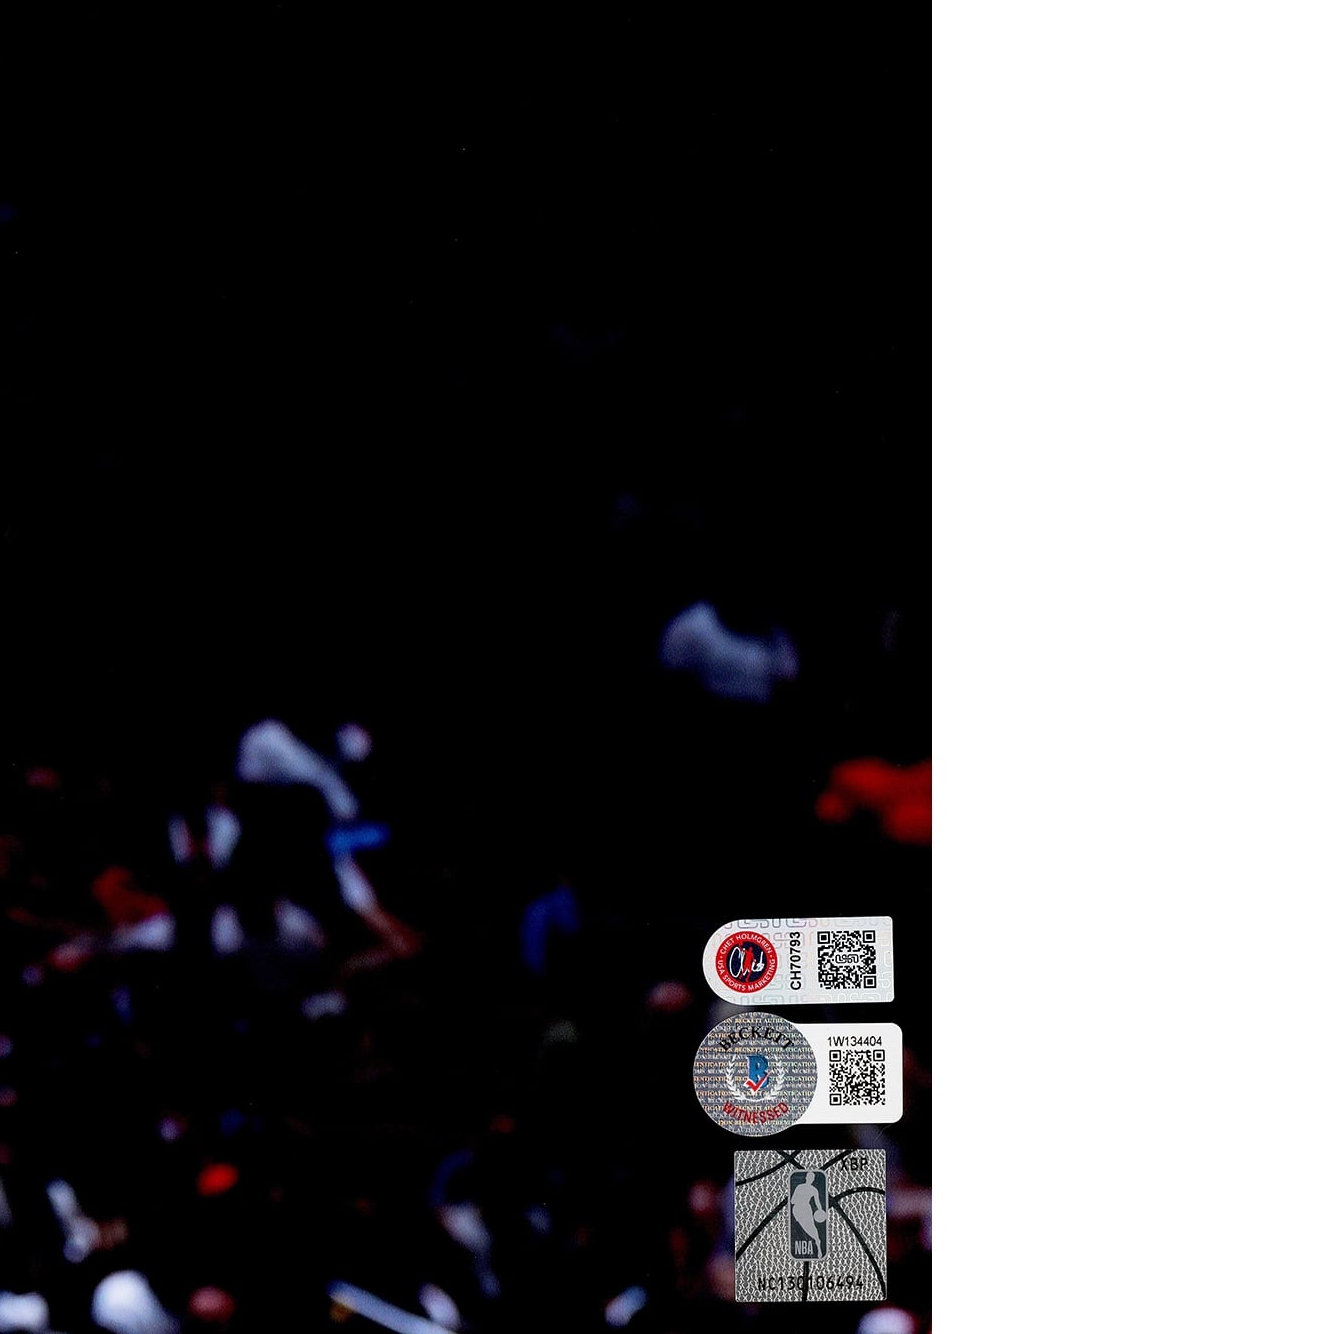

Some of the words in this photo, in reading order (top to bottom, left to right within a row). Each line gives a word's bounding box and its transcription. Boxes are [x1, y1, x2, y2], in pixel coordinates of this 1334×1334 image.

[720, 937, 735, 955] CHET
[735, 933, 773, 954] HOLMGREN
[790, 931, 801, 991] CH70793
[722, 974, 746, 991] SPORTS
[747, 959, 776, 991] MARKETING
[718, 1025, 795, 1052] BECKETT
[827, 1035, 883, 1047] 1W134404
[722, 1100, 789, 1124] WITNESSED
[794, 1240, 814, 1255] NBA
